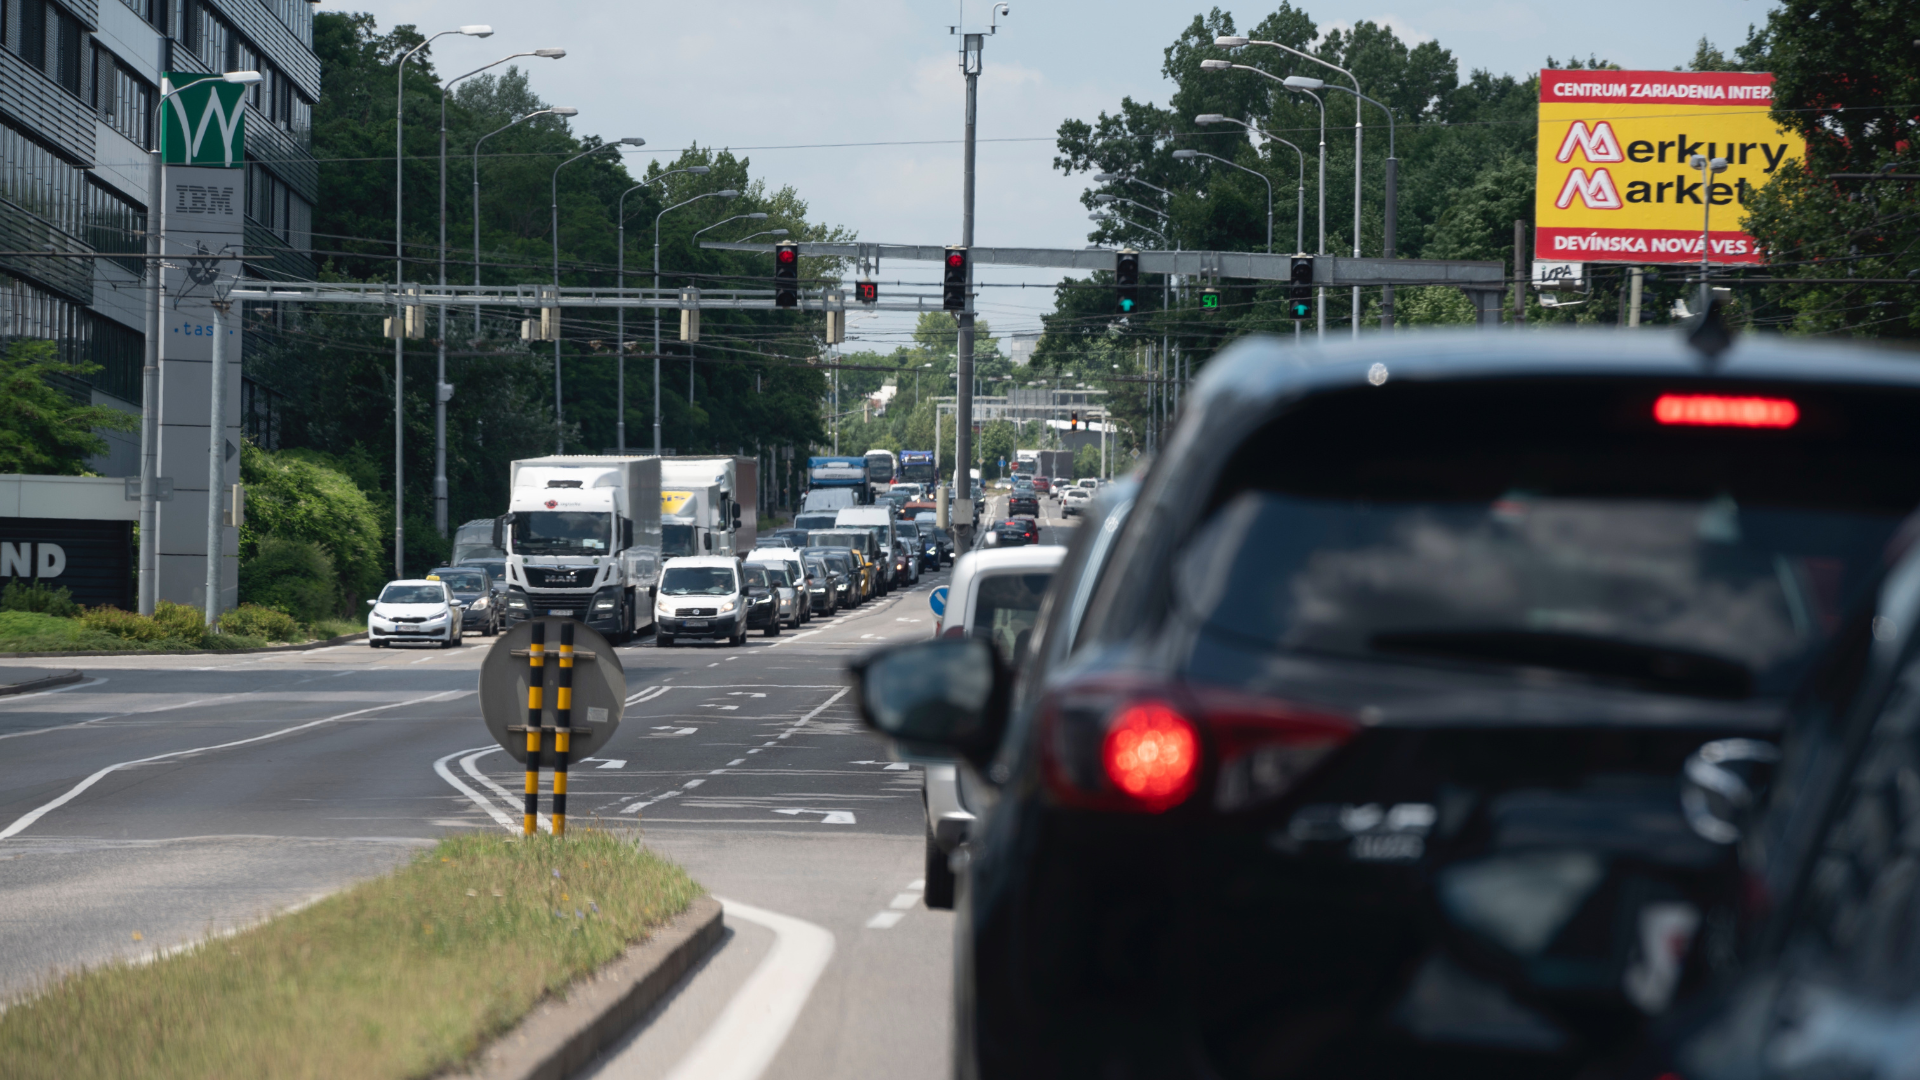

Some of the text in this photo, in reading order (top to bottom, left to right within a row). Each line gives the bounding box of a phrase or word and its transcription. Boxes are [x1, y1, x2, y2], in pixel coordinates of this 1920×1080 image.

[1553, 82, 1776, 99] CENTRUM ZARIADENIA INTER
[1555, 119, 1789, 174] Merkury
[176, 184, 233, 215] IBM
[1554, 166, 1746, 210] Market
[1554, 232, 1648, 252] DEVÍNSKA
[1651, 234, 1706, 254] NOVÁ
[1711, 239, 1747, 255] VES
[1202, 294, 1218, 308] 50
[183, 321, 214, 336] tas
